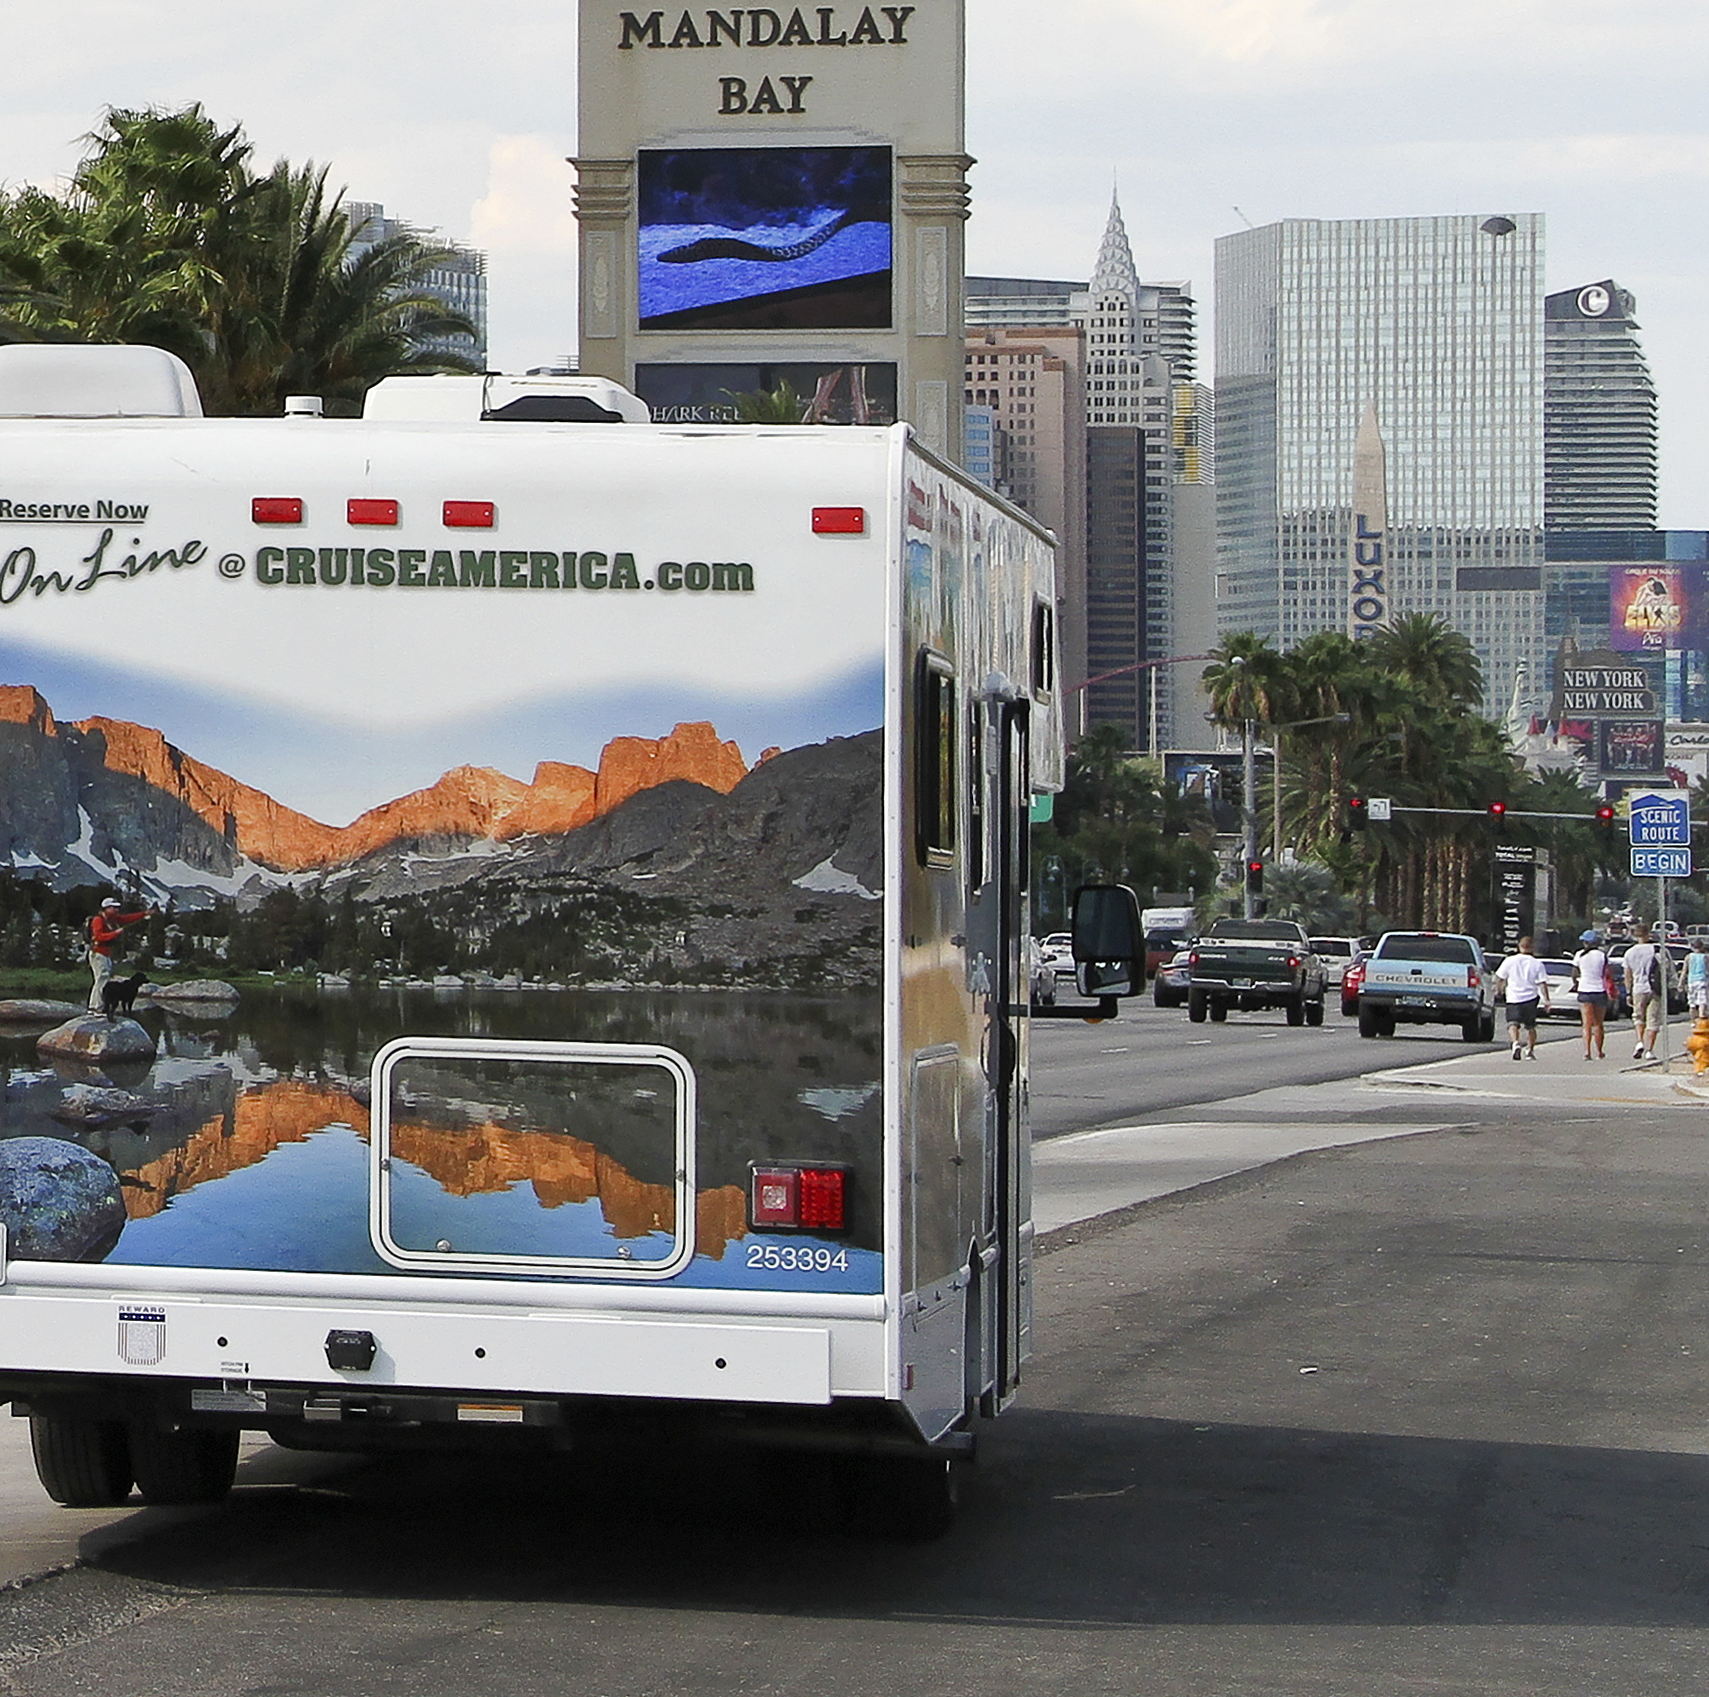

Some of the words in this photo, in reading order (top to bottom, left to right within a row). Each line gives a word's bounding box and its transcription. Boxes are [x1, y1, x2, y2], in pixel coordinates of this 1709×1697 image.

[618, 6, 915, 50] MANDALAY
[718, 75, 813, 115] BAY
[652, 406, 703, 422] HARK
[96, 500, 149, 519] Now
[218, 553, 246, 579] @
[256, 546, 755, 592] CRUISEAMERICA.com
[1563, 670, 1599, 688] NEW
[1602, 670, 1644, 688] YORK
[1563, 692, 1599, 709] NEW
[1602, 692, 1644, 709] YORK
[1640, 810, 1681, 824] SCENIC
[1641, 827, 1680, 841] ROUTE
[1635, 853, 1687, 870] BEGIN
[1375, 974, 1458, 985] CHEVROLET
[746, 1245, 849, 1272] 253394
[119, 1305, 165, 1314] REWARD
